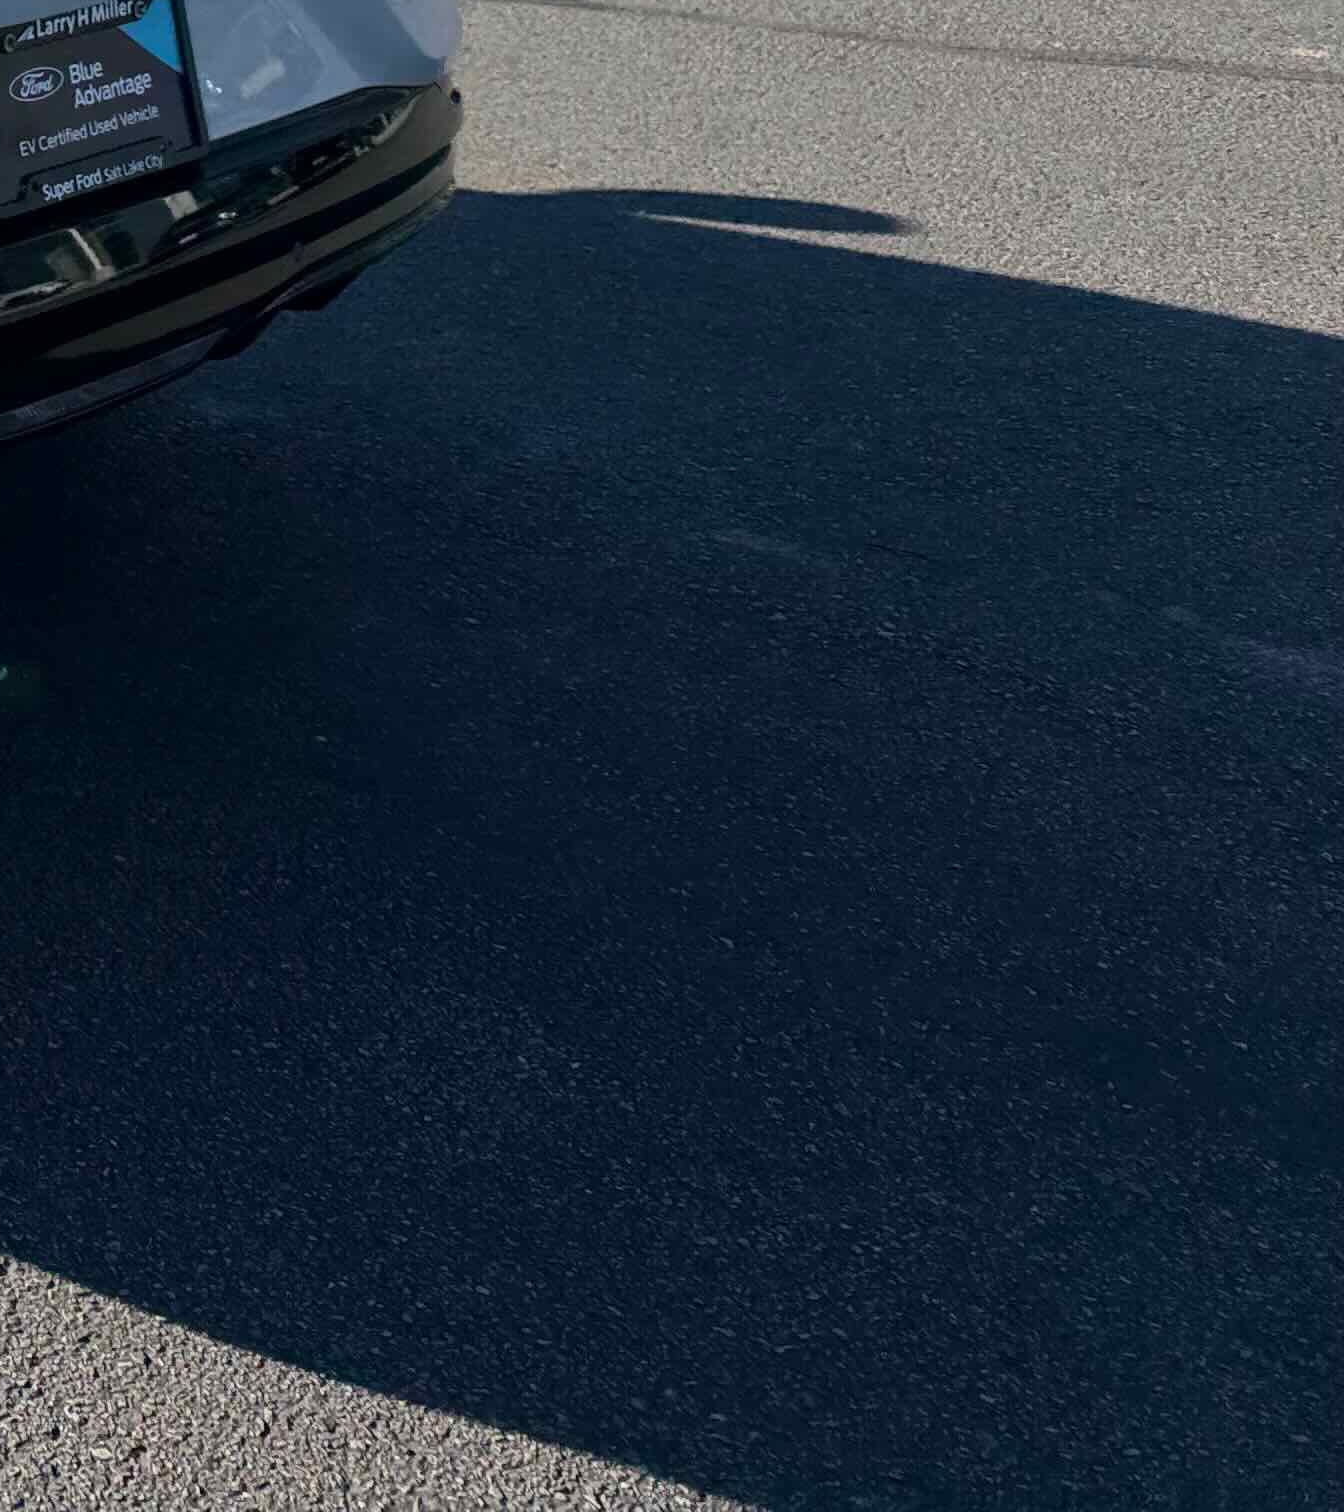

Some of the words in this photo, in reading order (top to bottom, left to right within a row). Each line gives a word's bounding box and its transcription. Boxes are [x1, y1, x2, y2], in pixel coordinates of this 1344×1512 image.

[36, 13, 76, 37] Larry
[77, 9, 89, 28] H
[91, 0, 133, 24] Miller
[68, 61, 105, 85] Blue
[74, 71, 153, 109] Advantage
[18, 139, 37, 157] EV
[37, 124, 89, 152] Certified
[88, 118, 120, 136] Used
[119, 103, 160, 127] Vehicle
[42, 180, 76, 201] Super
[75, 167, 103, 190] Ford
[103, 163, 124, 182] Salt
[123, 157, 146, 177] Lake
